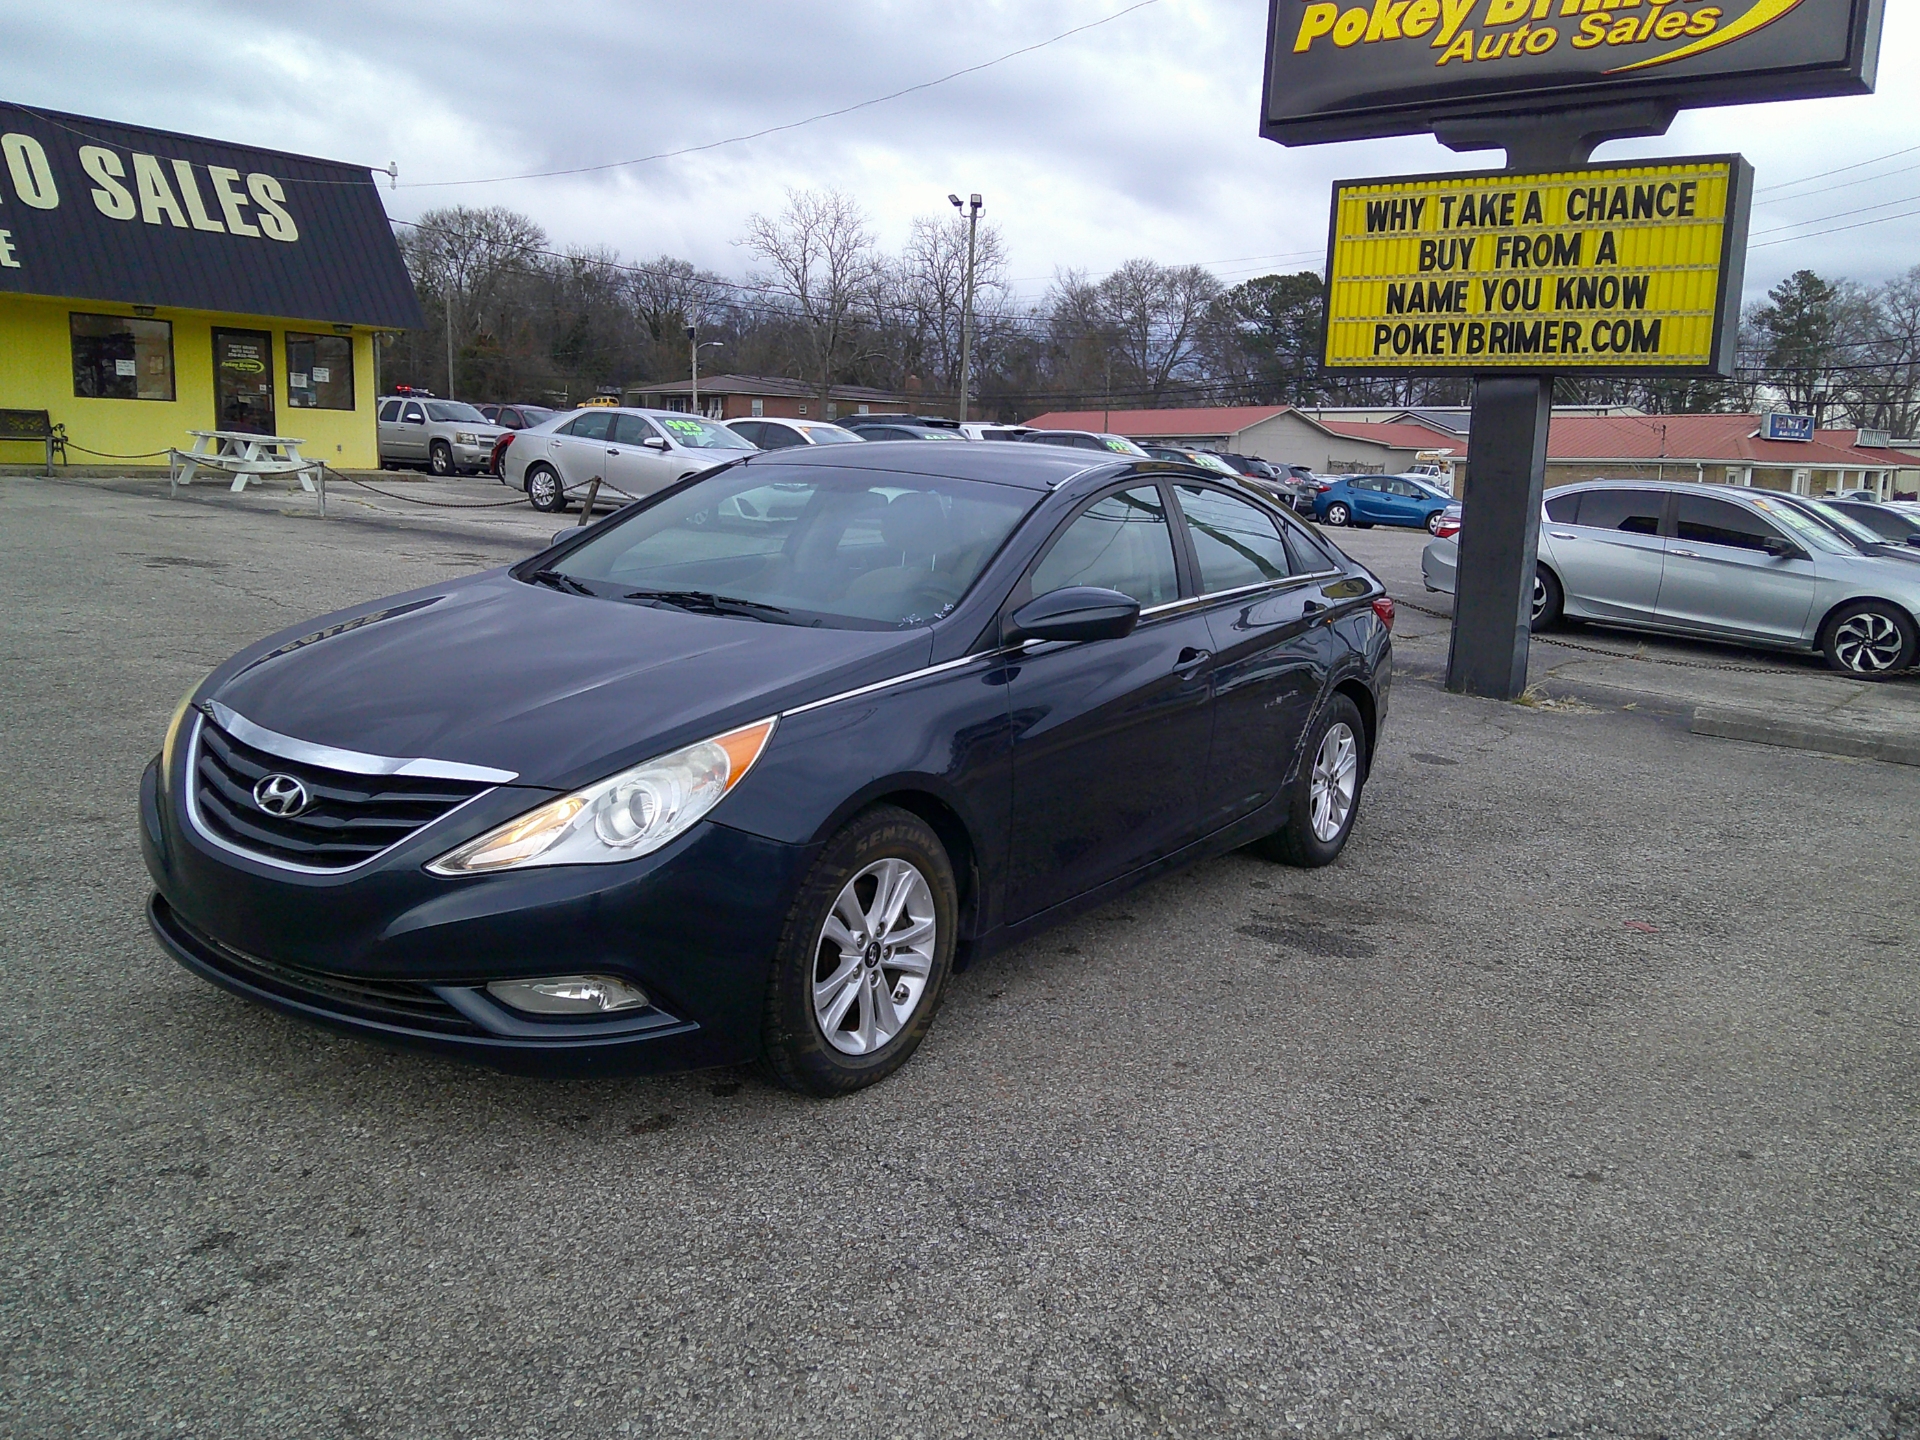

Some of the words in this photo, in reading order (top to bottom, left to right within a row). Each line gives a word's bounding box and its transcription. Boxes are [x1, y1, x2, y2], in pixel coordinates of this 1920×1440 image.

[1293, 0, 1475, 53] Pokey
[1435, 23, 1558, 66] Auto
[1571, 5, 1723, 49] Sales
[0, 132, 59, 210] O
[79, 145, 299, 242] SALES
[1366, 197, 1425, 232] WHY
[1440, 192, 1514, 228] TAKE
[1521, 190, 1543, 224] A
[1566, 182, 1697, 221] CHANCE
[1419, 237, 1476, 272] BUY
[1495, 232, 1583, 269] FROM
[1595, 231, 1617, 265] A
[1385, 280, 1468, 314] NAME
[1482, 277, 1542, 311] YOU
[1554, 275, 1650, 310] KNOW
[1373, 318, 1662, 355] POKEYBRIMER.COM
[665, 420, 702, 431] 995
